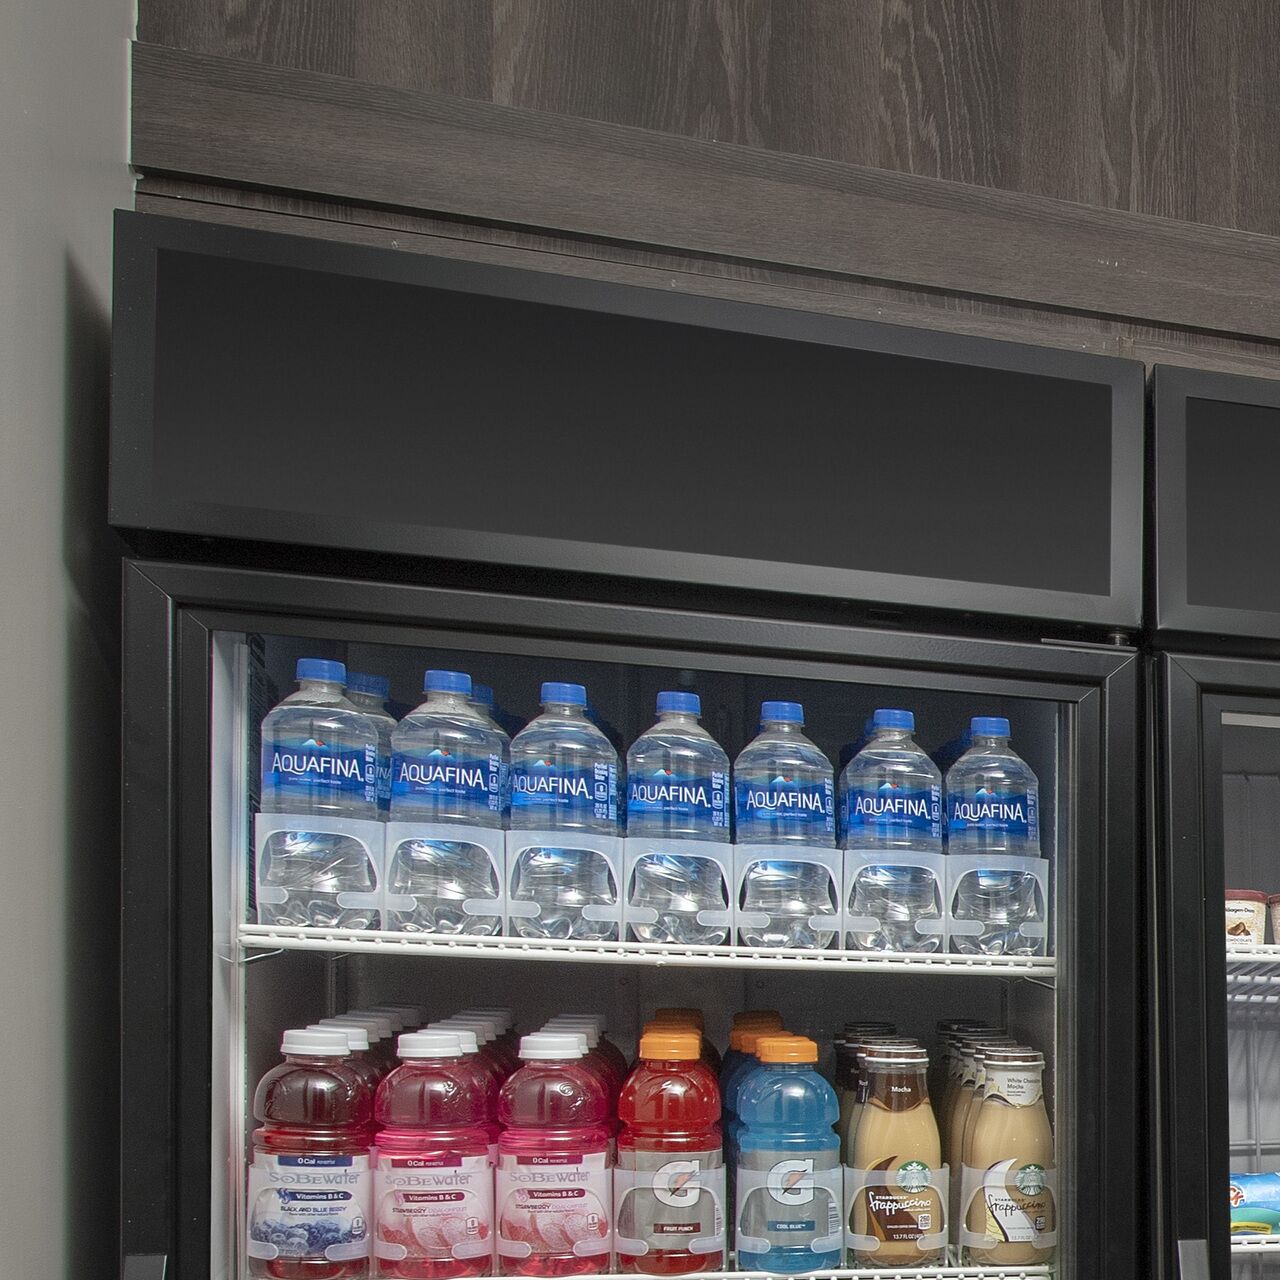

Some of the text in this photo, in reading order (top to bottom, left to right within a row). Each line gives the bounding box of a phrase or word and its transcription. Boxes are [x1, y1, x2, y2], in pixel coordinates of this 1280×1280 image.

[271, 752, 363, 782] AQUAFINA
[399, 761, 487, 790] AQUAFINA
[512, 773, 592, 799] AQUAFINA
[631, 784, 711, 808] AQUAFINA
[746, 790, 825, 813] AQUAFINA
[855, 796, 930, 819] AQUAFINA
[954, 802, 1026, 822] AQUAFINA
[303, 1157, 315, 1165] Cal
